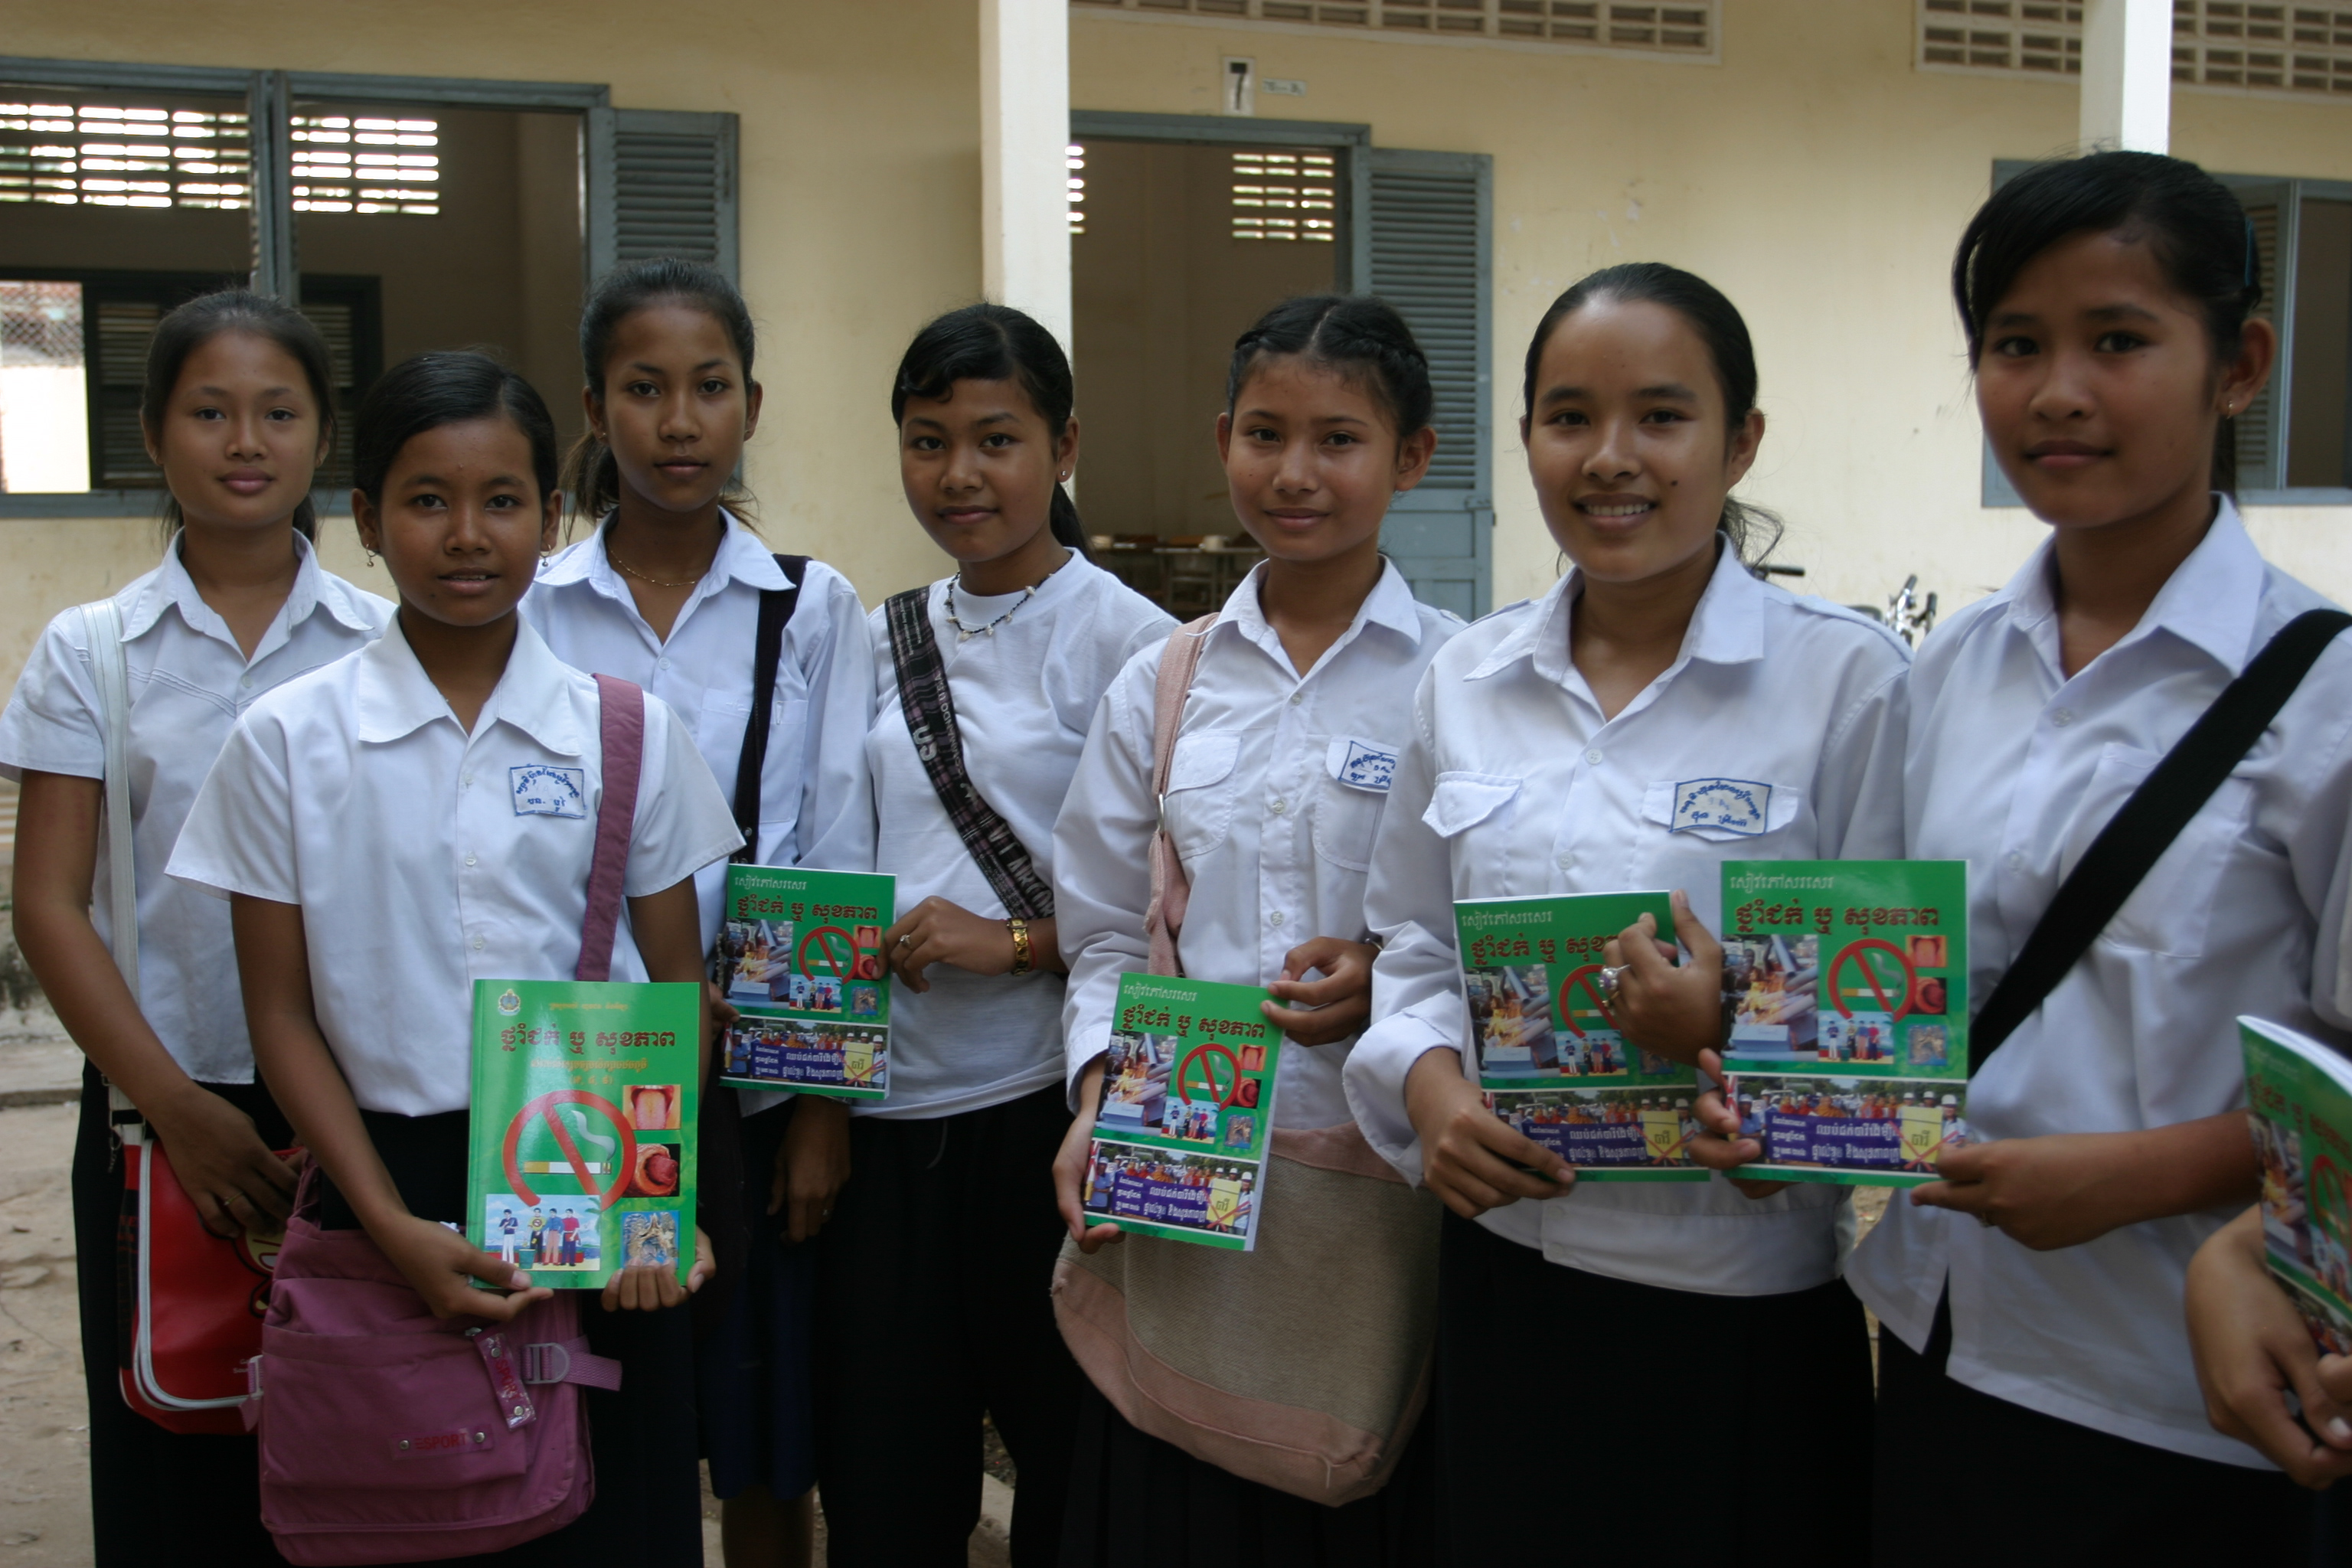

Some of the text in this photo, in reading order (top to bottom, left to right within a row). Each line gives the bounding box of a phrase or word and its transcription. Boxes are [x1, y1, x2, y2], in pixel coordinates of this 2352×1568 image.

[1566, 934, 1619, 962] សុខ
[596, 1031, 675, 1055] សុខភាព
